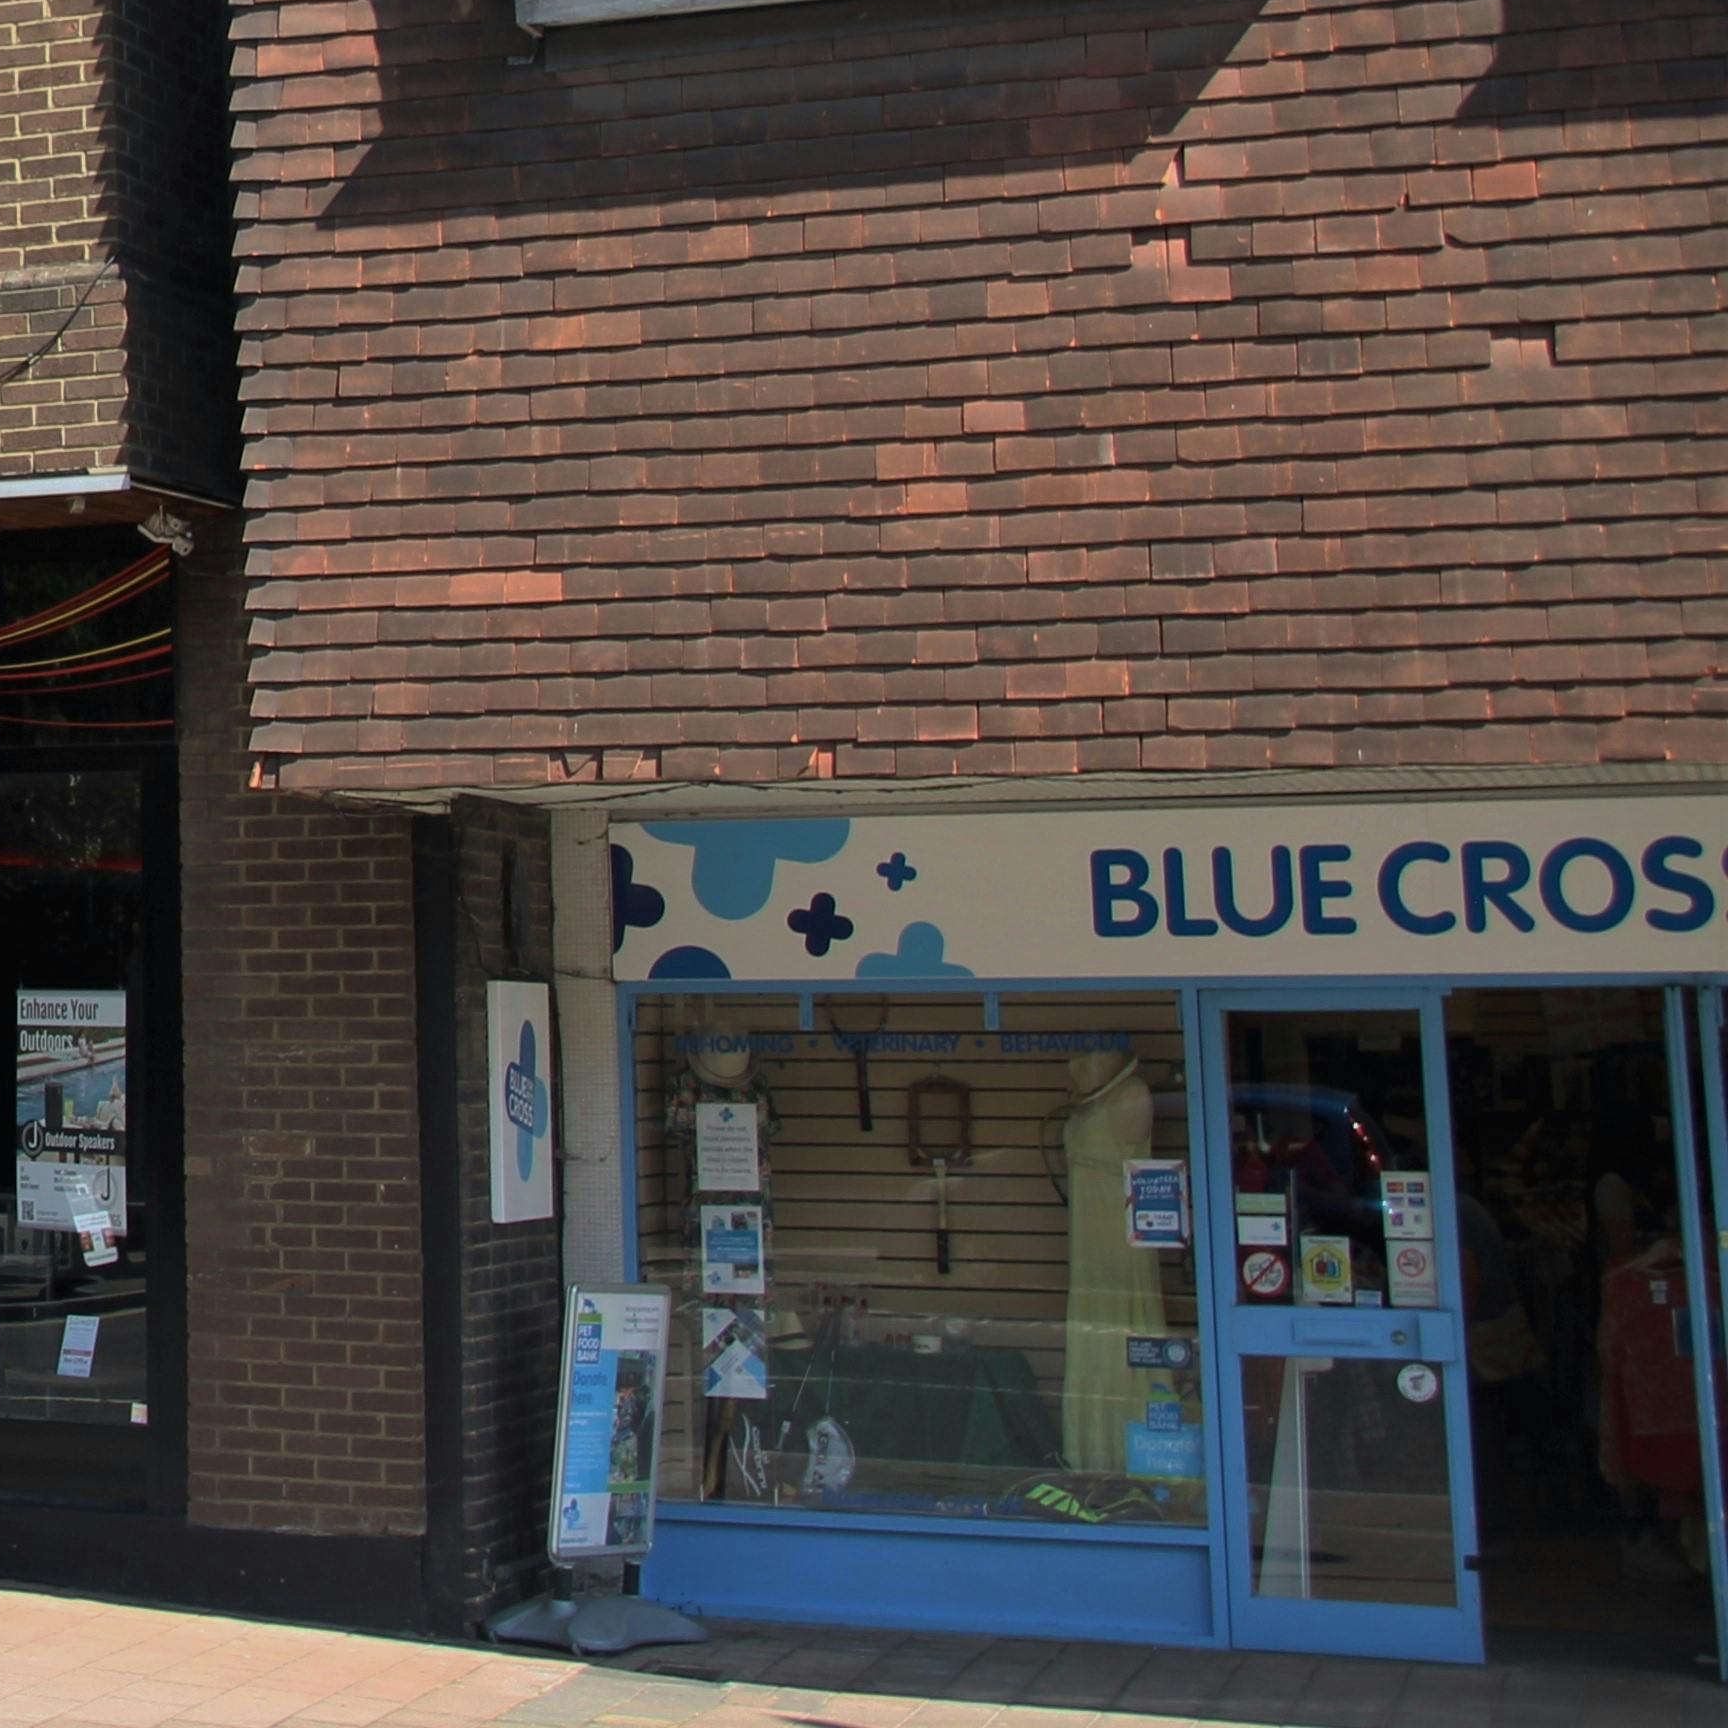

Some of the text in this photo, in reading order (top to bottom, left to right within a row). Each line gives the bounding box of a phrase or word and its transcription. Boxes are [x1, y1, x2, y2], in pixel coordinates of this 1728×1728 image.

[1090, 836, 1728, 938] BLUE CROS
[19, 998, 100, 1021] Enhance Your
[19, 1029, 74, 1052] Outdoors
[832, 1033, 961, 1053] VETERINARY
[509, 1066, 529, 1095] BLUE
[508, 1093, 534, 1128] CROSS
[45, 1131, 78, 1149] Outdoor
[78, 1133, 116, 1153] Speakers
[577, 1324, 593, 1338] PET
[577, 1337, 601, 1350] FOOD
[575, 1349, 599, 1362] BANK
[574, 1371, 609, 1386] Donate
[574, 1391, 594, 1405] here
[1134, 1435, 1199, 1453] Donate
